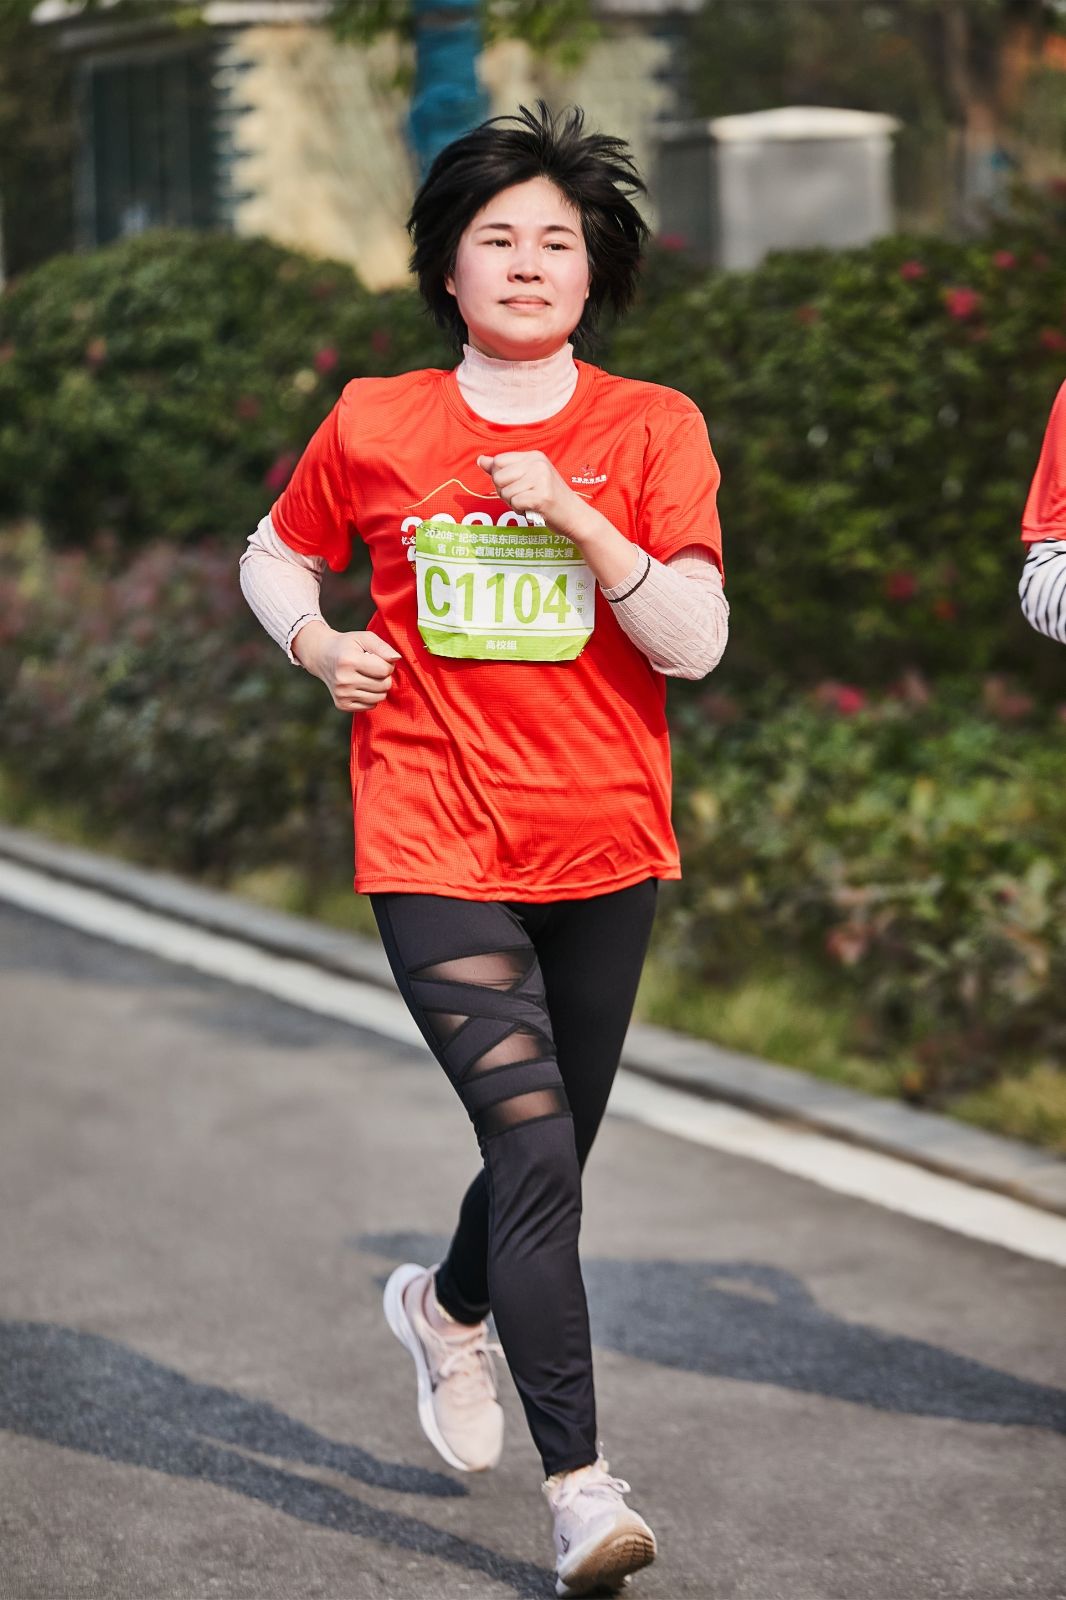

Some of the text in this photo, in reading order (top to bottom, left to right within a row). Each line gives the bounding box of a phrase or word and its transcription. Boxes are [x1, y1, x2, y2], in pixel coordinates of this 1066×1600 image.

[424, 566, 572, 624] C1104
[486, 639, 517, 651] 高校组
